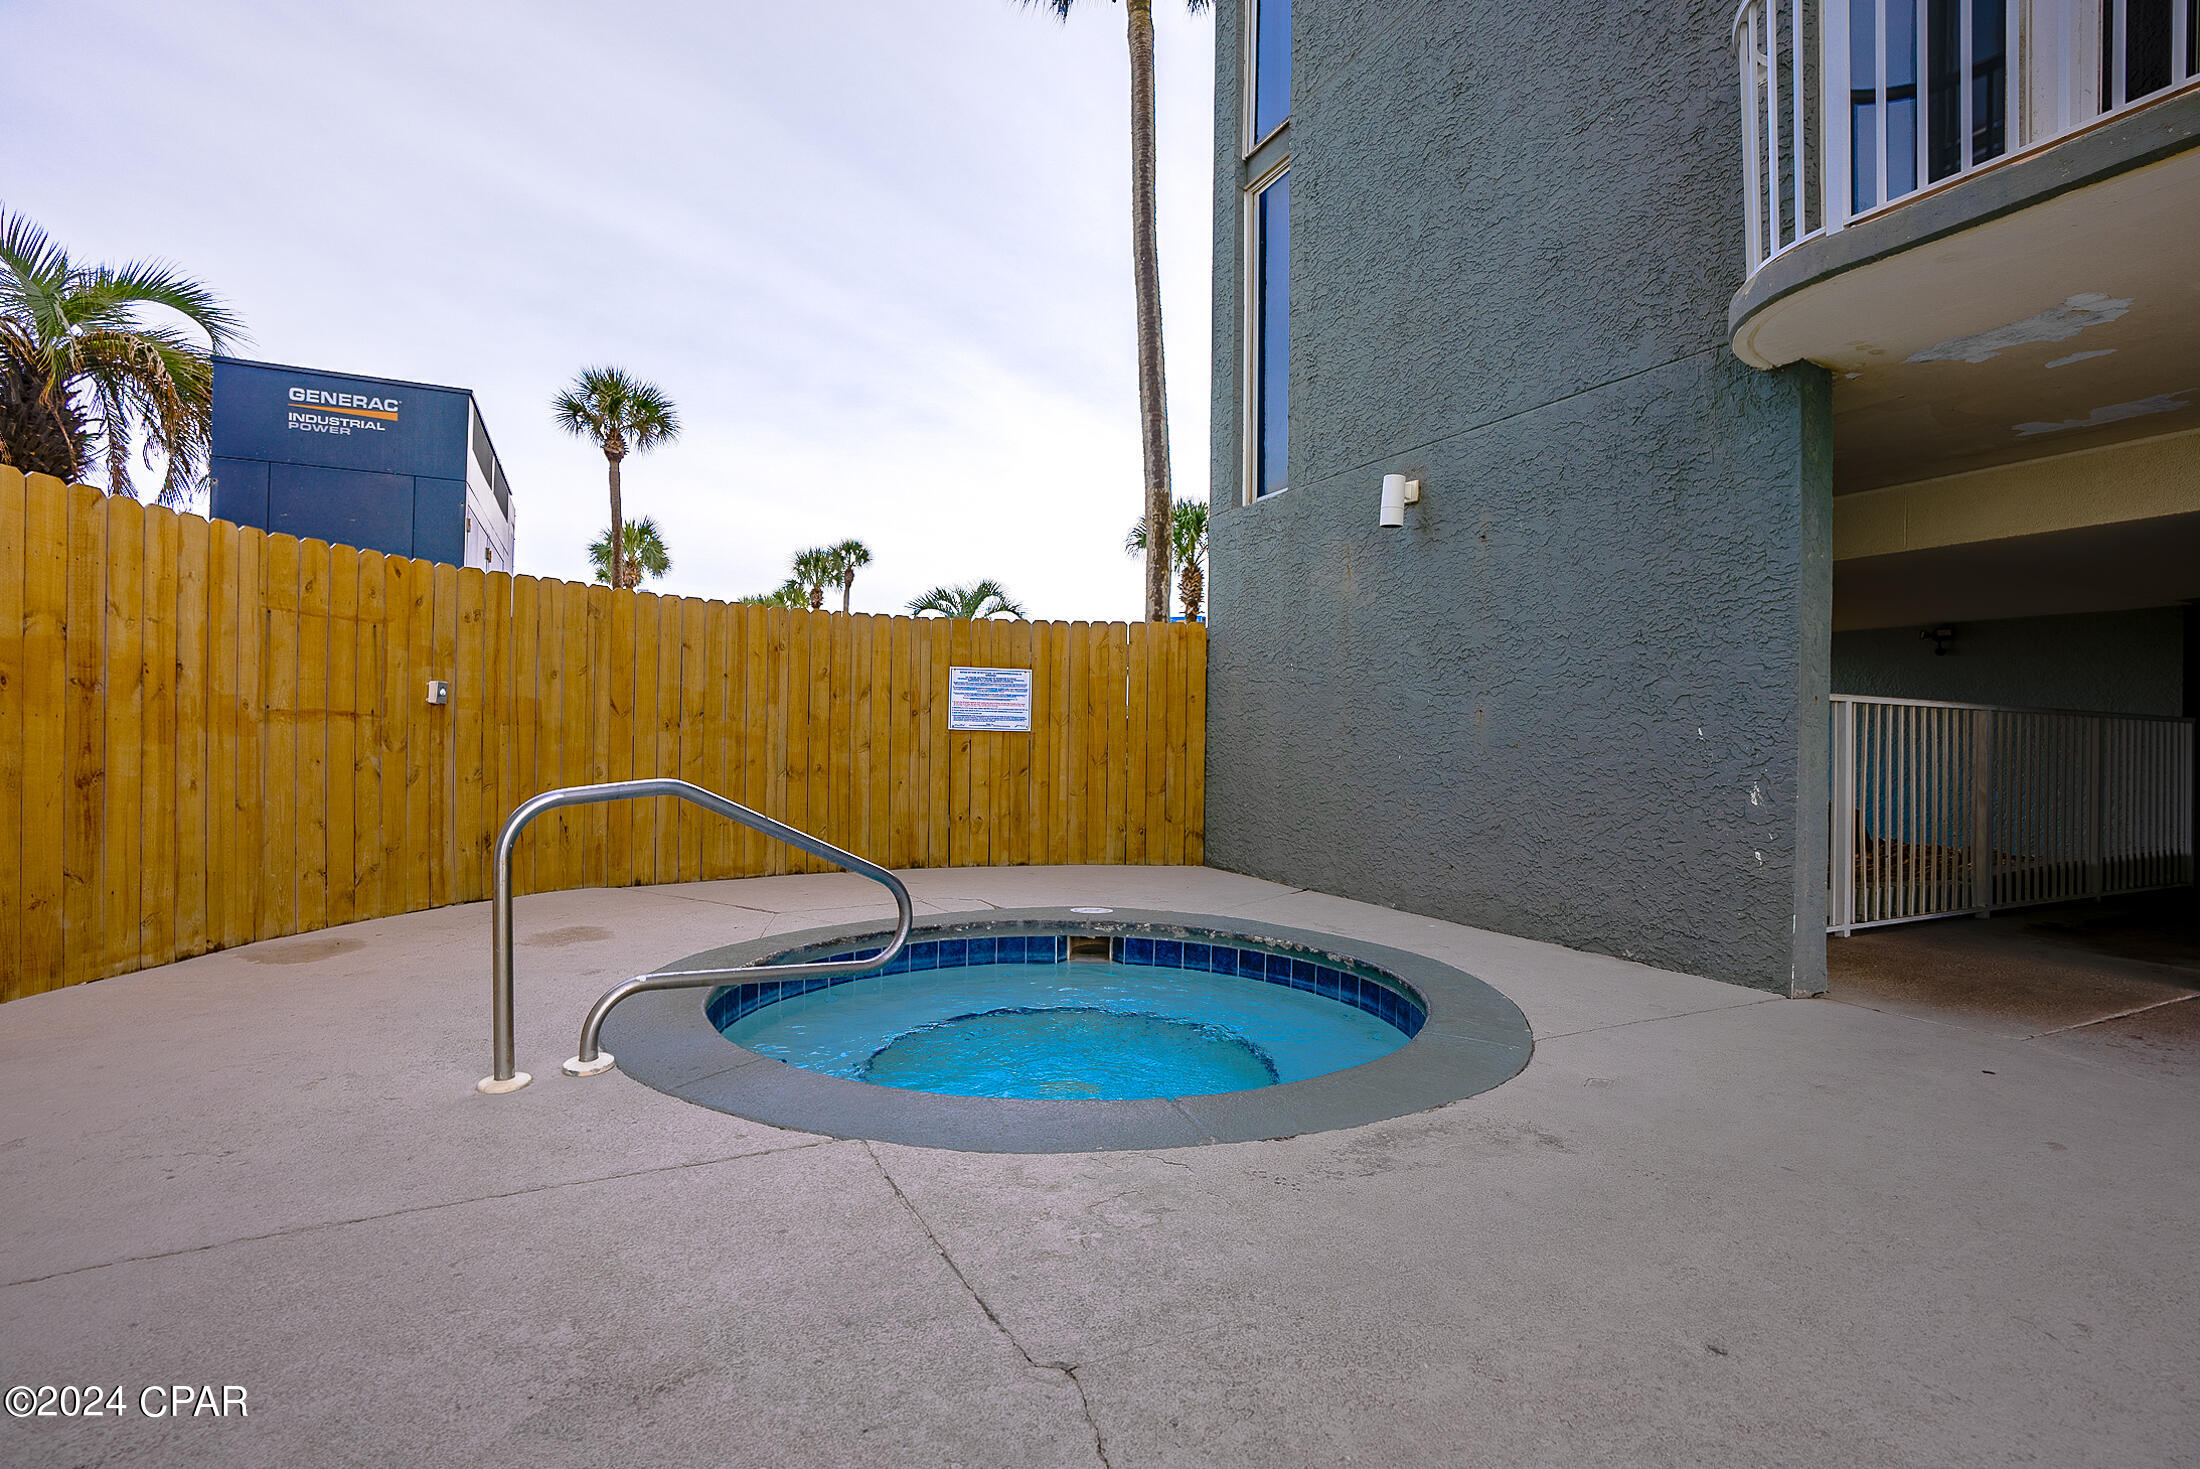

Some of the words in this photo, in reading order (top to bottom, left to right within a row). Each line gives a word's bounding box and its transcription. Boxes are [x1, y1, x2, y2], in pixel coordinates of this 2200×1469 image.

[288, 387, 399, 412] GENERAC
[288, 412, 386, 431] INDUSTRIAL
[288, 421, 351, 435] POWER
